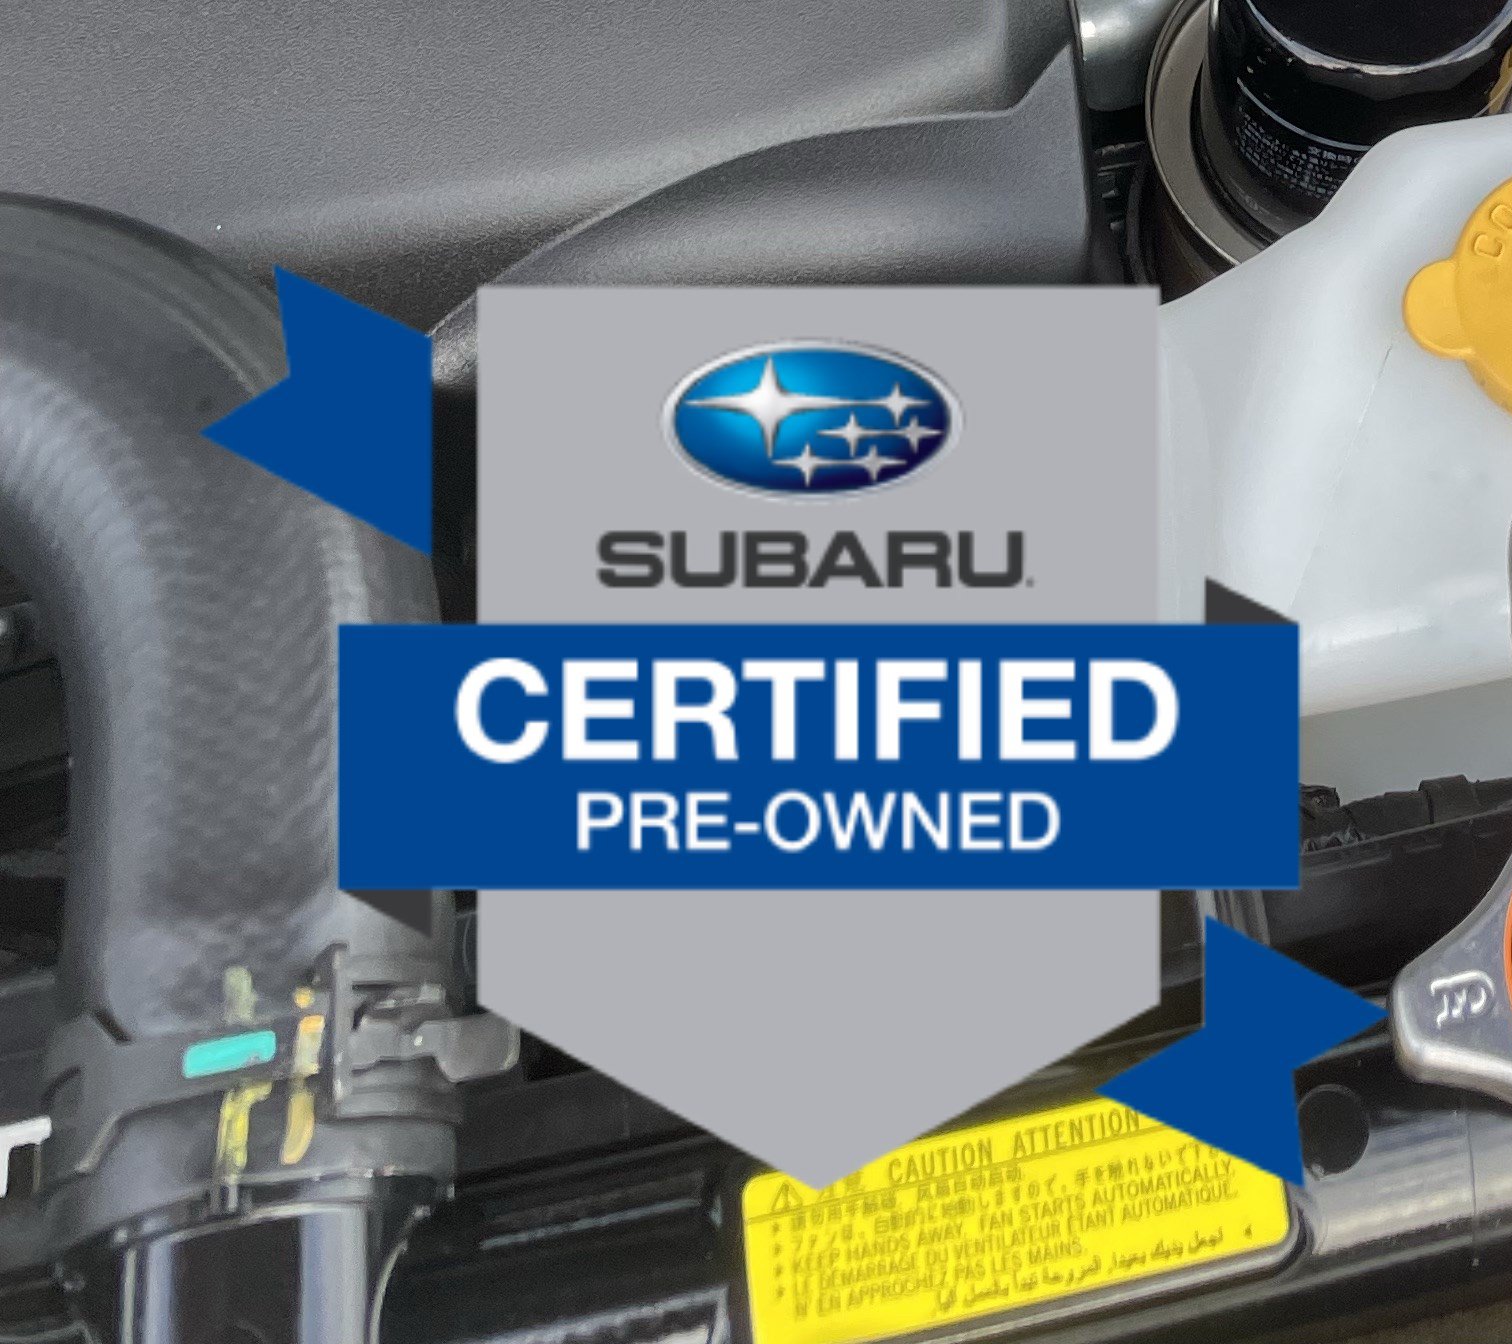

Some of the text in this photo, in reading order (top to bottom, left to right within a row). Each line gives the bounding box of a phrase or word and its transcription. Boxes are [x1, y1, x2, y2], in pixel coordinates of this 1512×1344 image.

[884, 1102, 1142, 1187] CAUTION ATTENTION
[1018, 1191, 1087, 1223] STARTS
